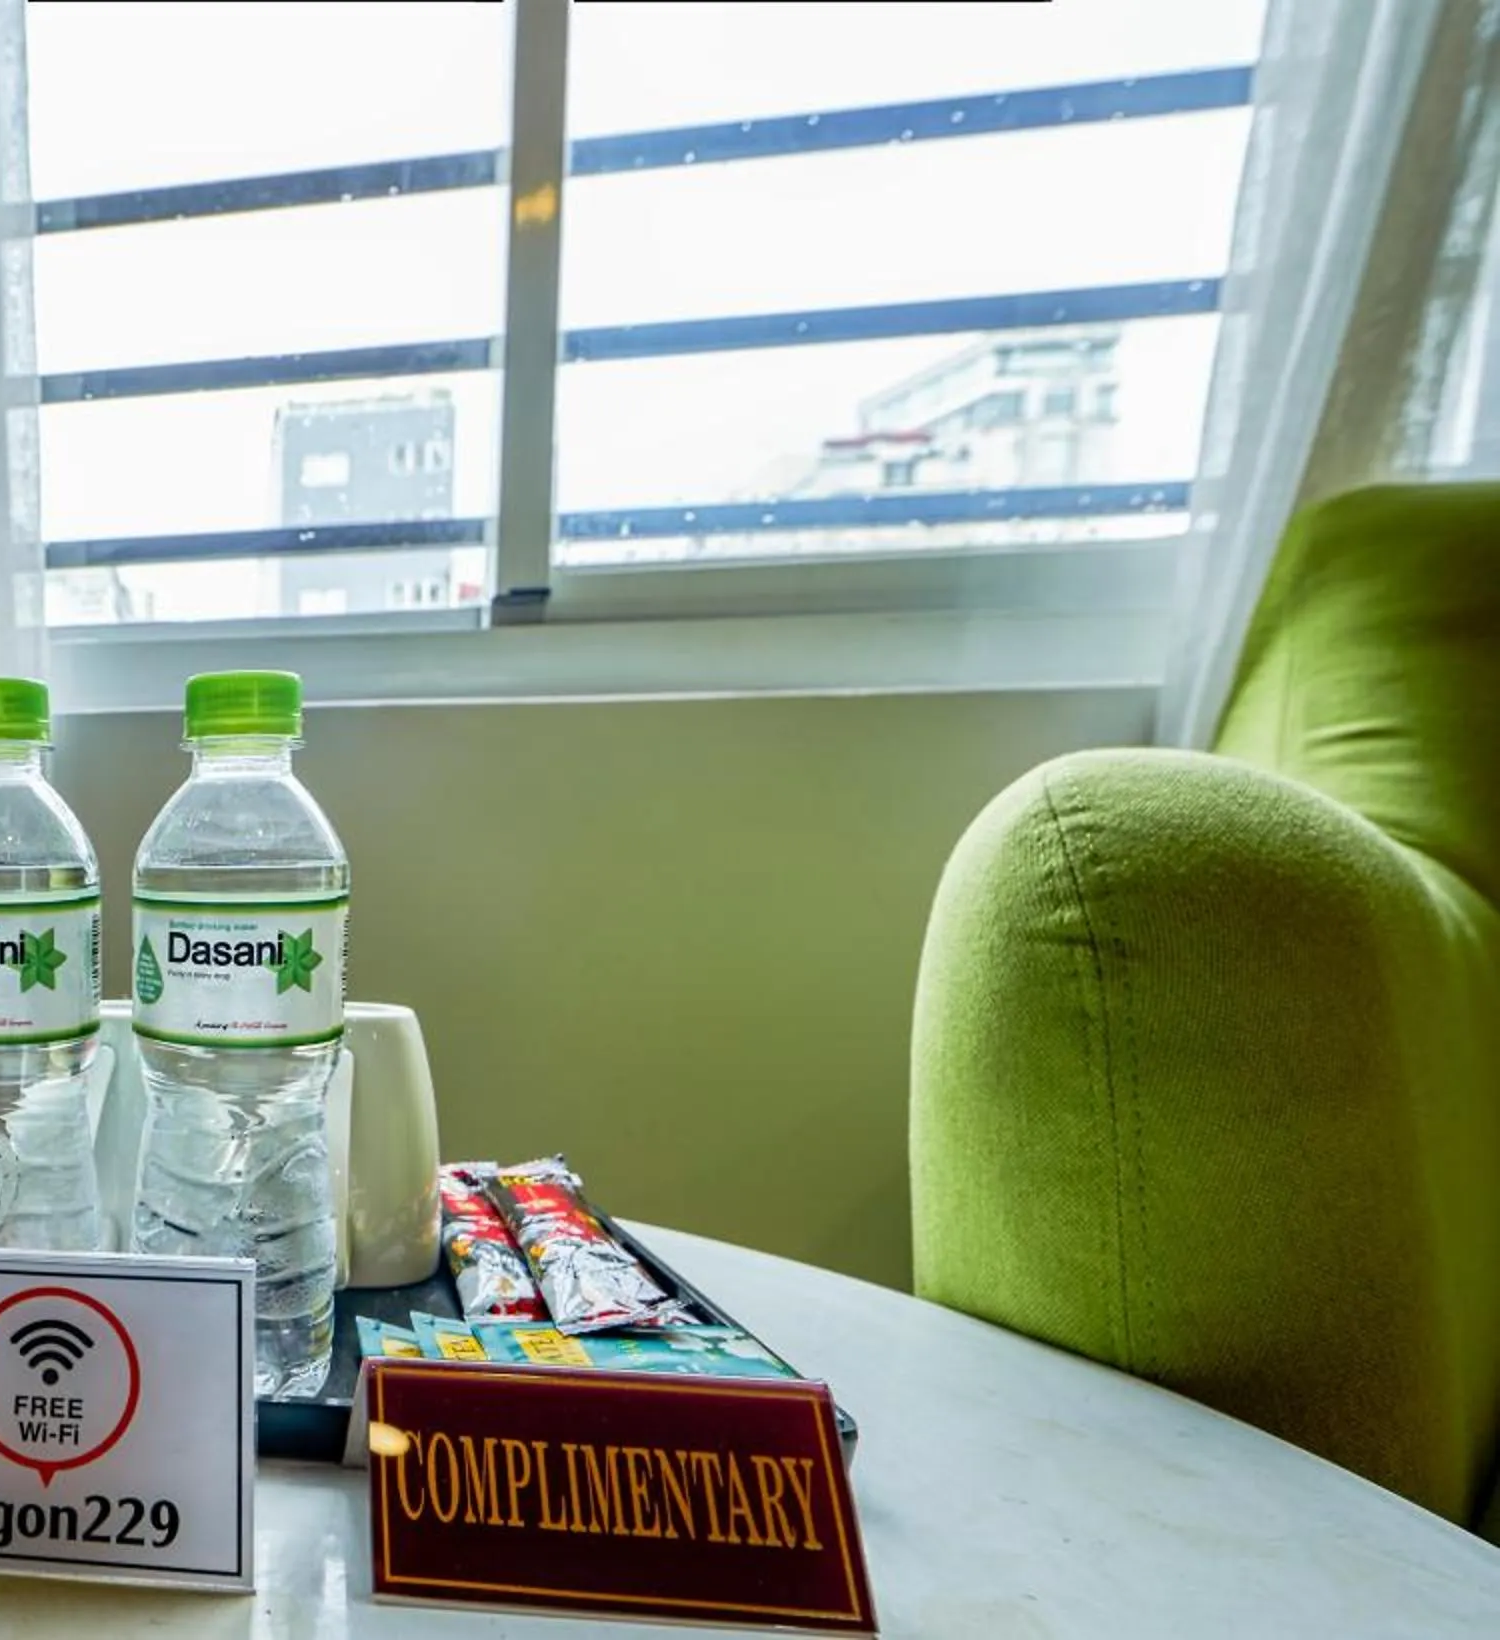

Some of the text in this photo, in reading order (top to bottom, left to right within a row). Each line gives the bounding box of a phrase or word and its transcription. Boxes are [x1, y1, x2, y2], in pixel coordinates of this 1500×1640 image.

[167, 930, 284, 967] Dasani
[13, 1394, 84, 1420] FREE
[19, 1421, 80, 1446] Wi-Fi
[396, 1429, 824, 1551] COMPLIMENTARY
